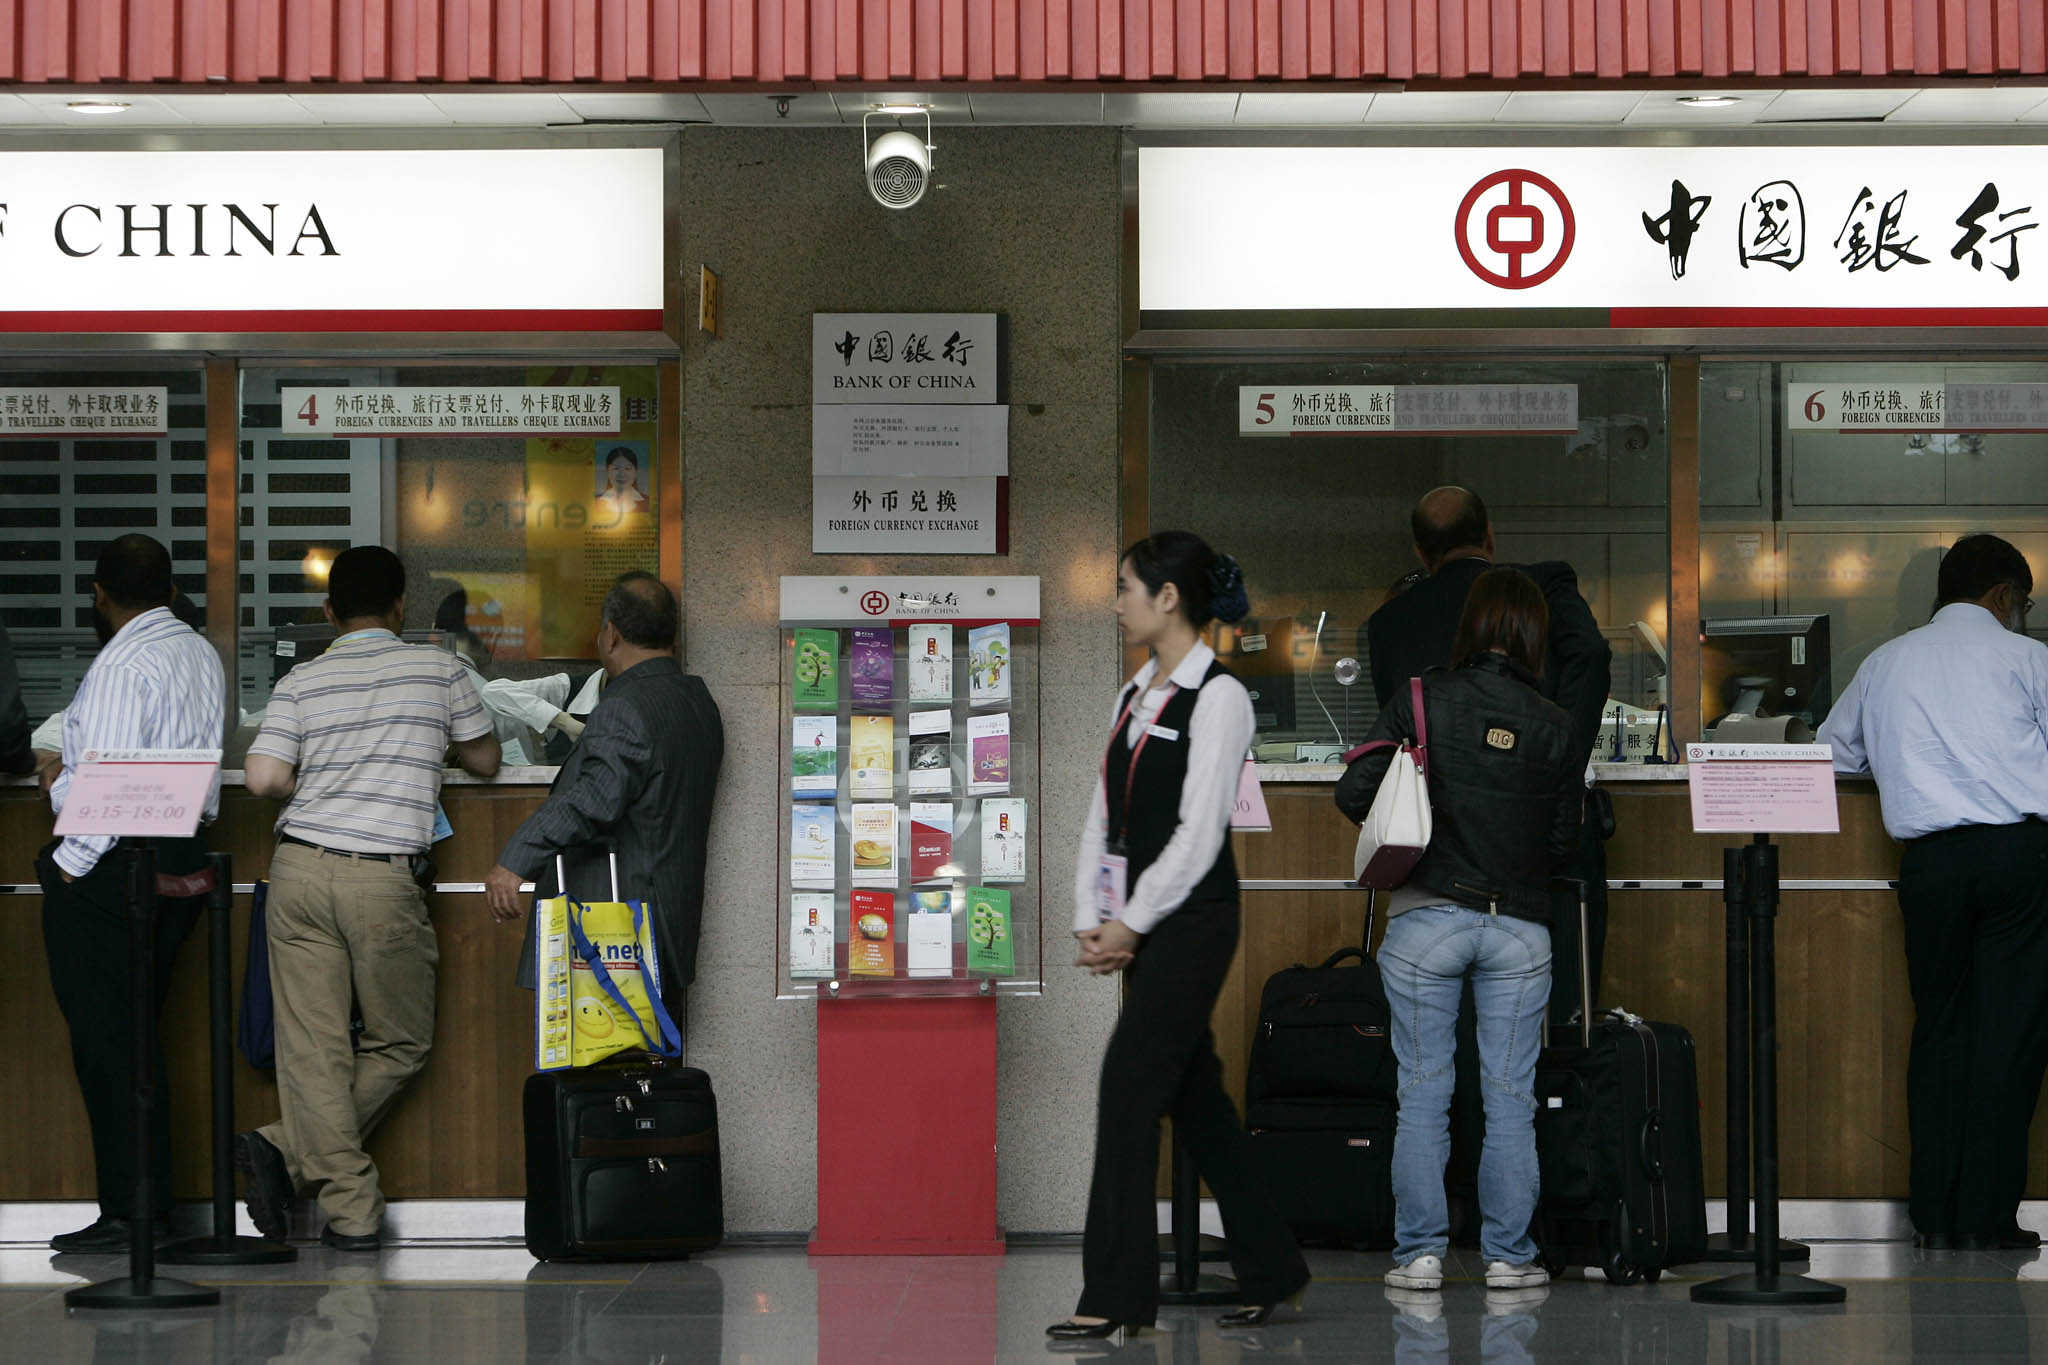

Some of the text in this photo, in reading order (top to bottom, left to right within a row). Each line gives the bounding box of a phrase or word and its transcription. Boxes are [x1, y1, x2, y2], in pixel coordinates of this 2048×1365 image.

[54, 203, 341, 258] CHINA
[1641, 179, 2041, 282] 中國銀行
[834, 330, 975, 367] 中國銀行
[833, 375, 977, 389] BANK OF CHINA
[0, 394, 160, 415] 票兑付、外卡取现业务
[297, 394, 319, 426] 4
[1255, 393, 1276, 425] 5
[1804, 390, 1826, 422] 6
[8, 416, 158, 429] TRAVELLERS CHEQUE EXCHANGE
[335, 415, 611, 428] FOREIGN CURRENCIES AND TRAVELLERS CHEQUE EXCHANGE
[1292, 414, 1331, 426] FOREIGN
[1336, 414, 1391, 426] CURRENCIES
[1841, 412, 1881, 423] FOREIGN
[1885, 412, 1941, 423] CURRENCIES
[852, 489, 957, 513] 外币兑换
[829, 519, 979, 531] FOREIGN CURRENCY EXCHANGE
